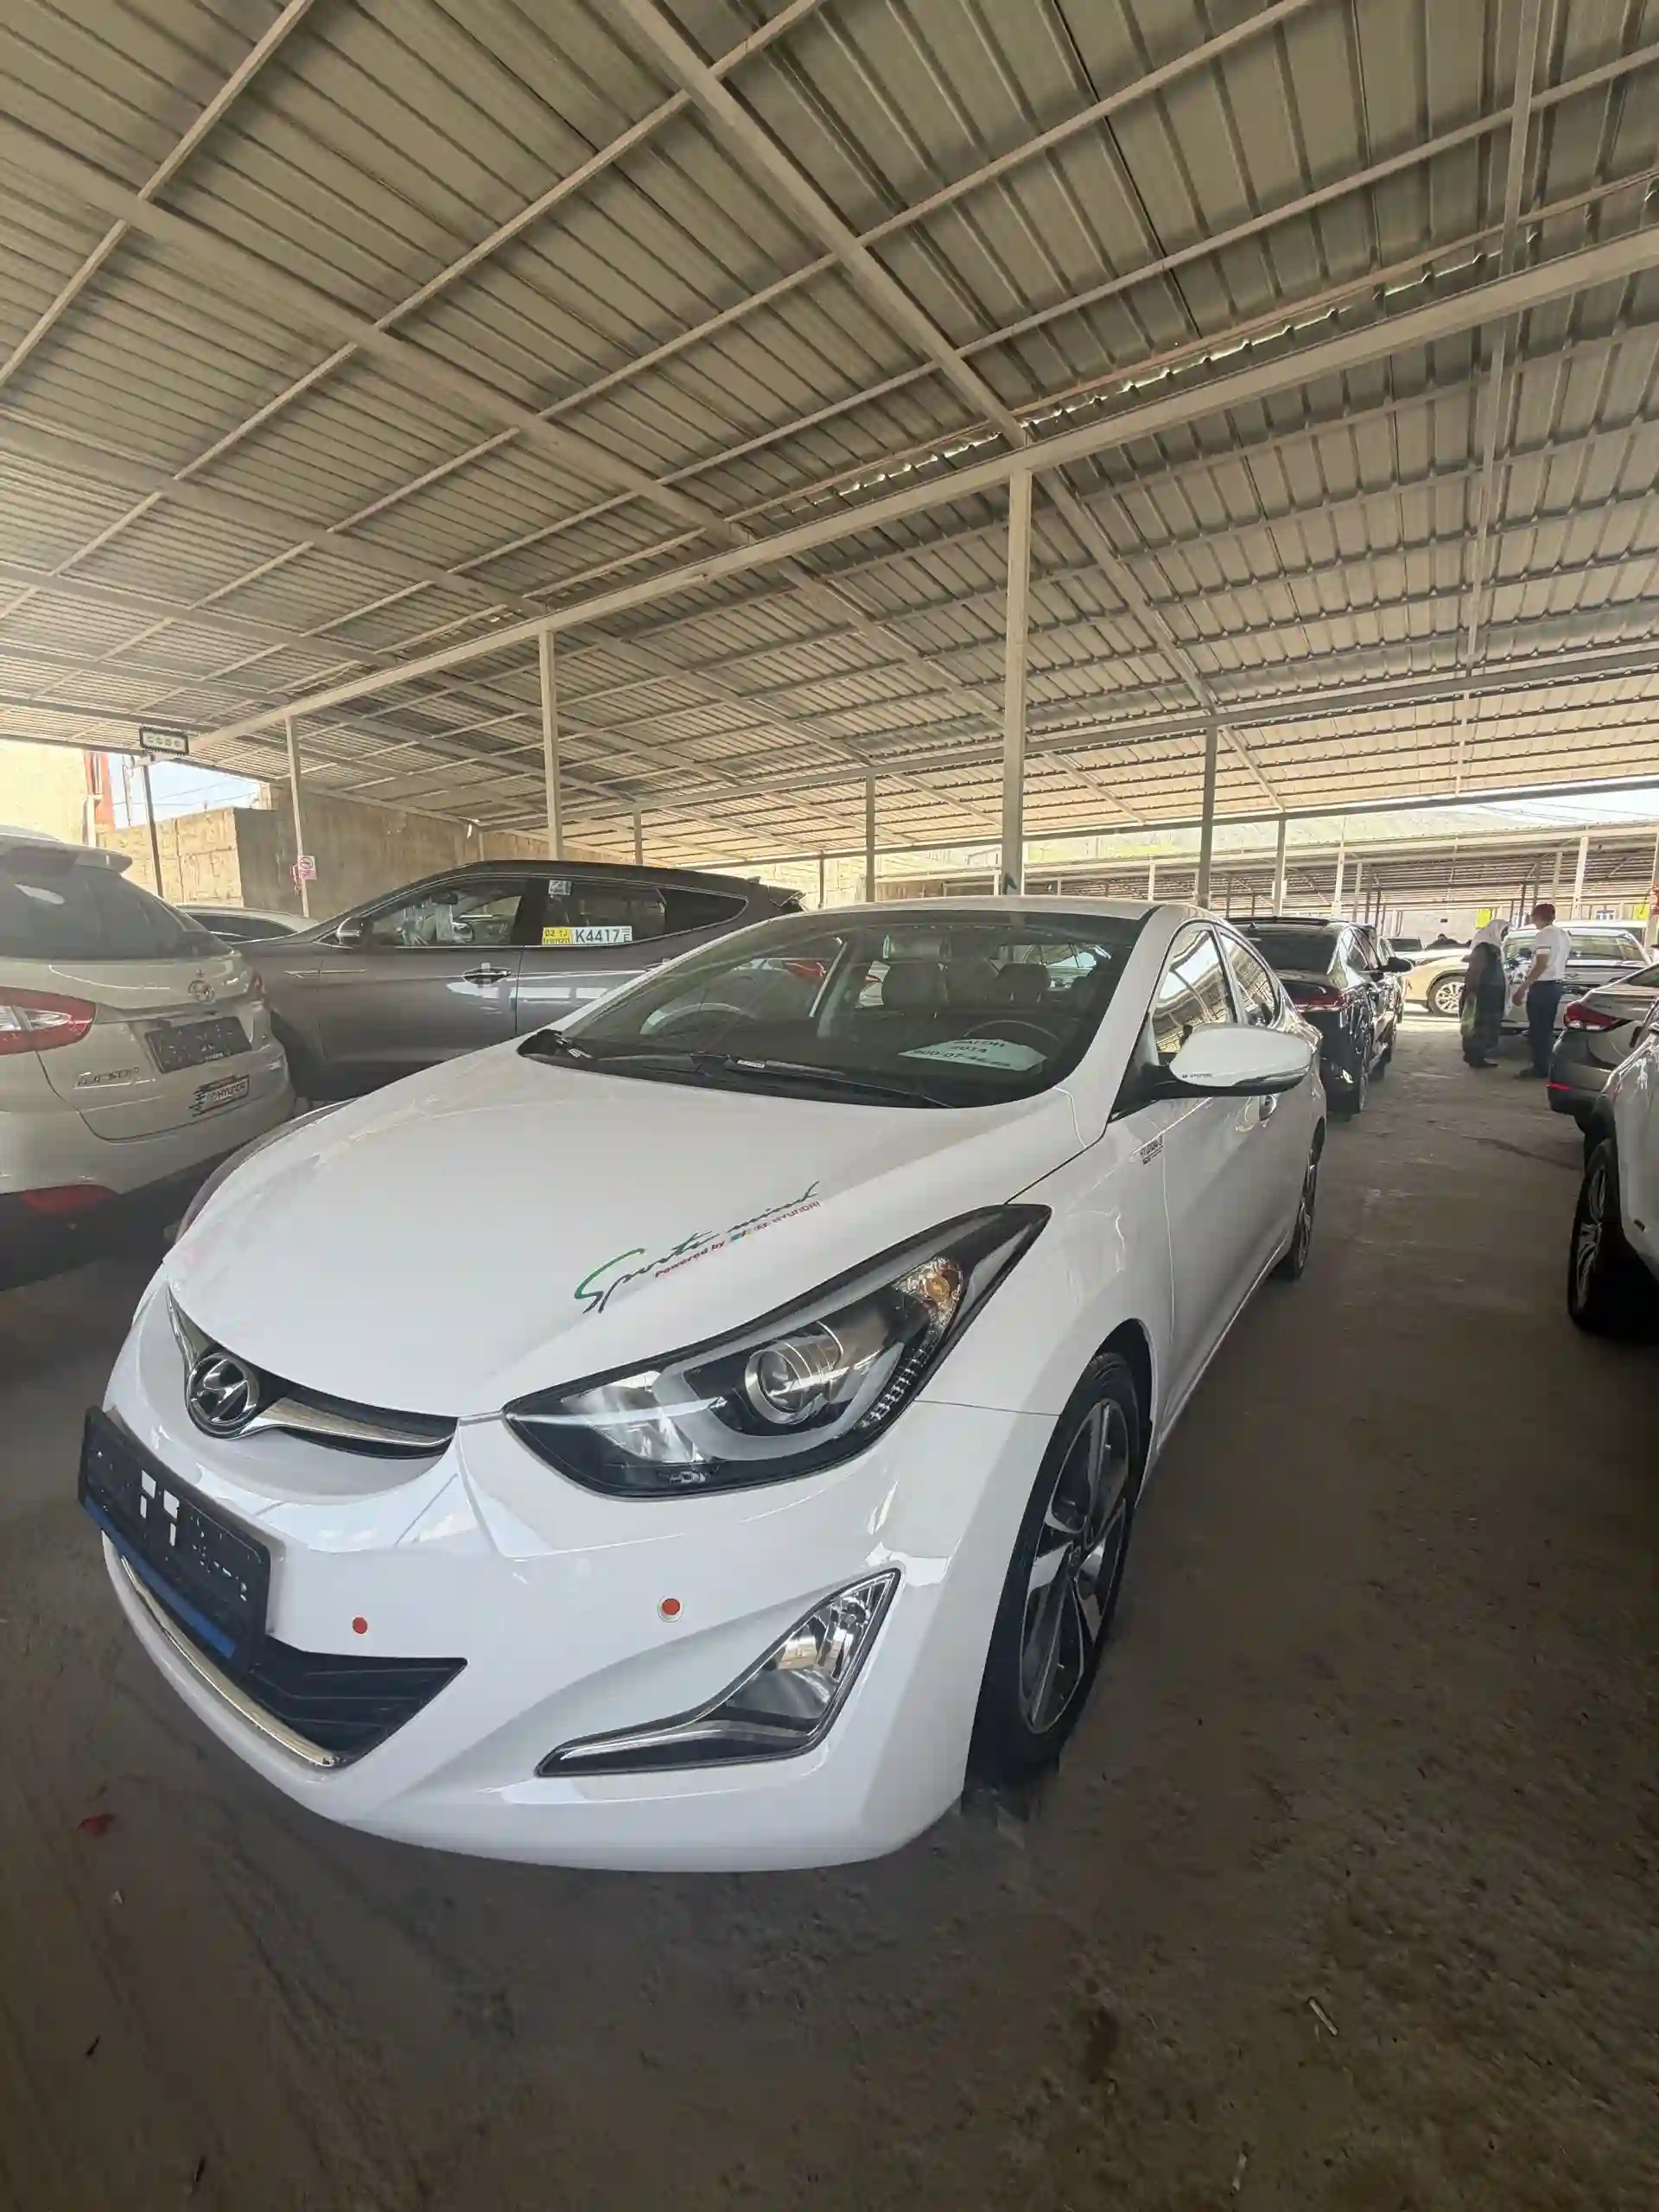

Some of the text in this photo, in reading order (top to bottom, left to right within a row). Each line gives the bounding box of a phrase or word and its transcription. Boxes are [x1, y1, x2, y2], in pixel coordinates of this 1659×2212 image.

[575, 929, 620, 944] K4417
[654, 1247, 709, 1278] Powered
[711, 1241, 726, 1251] by
